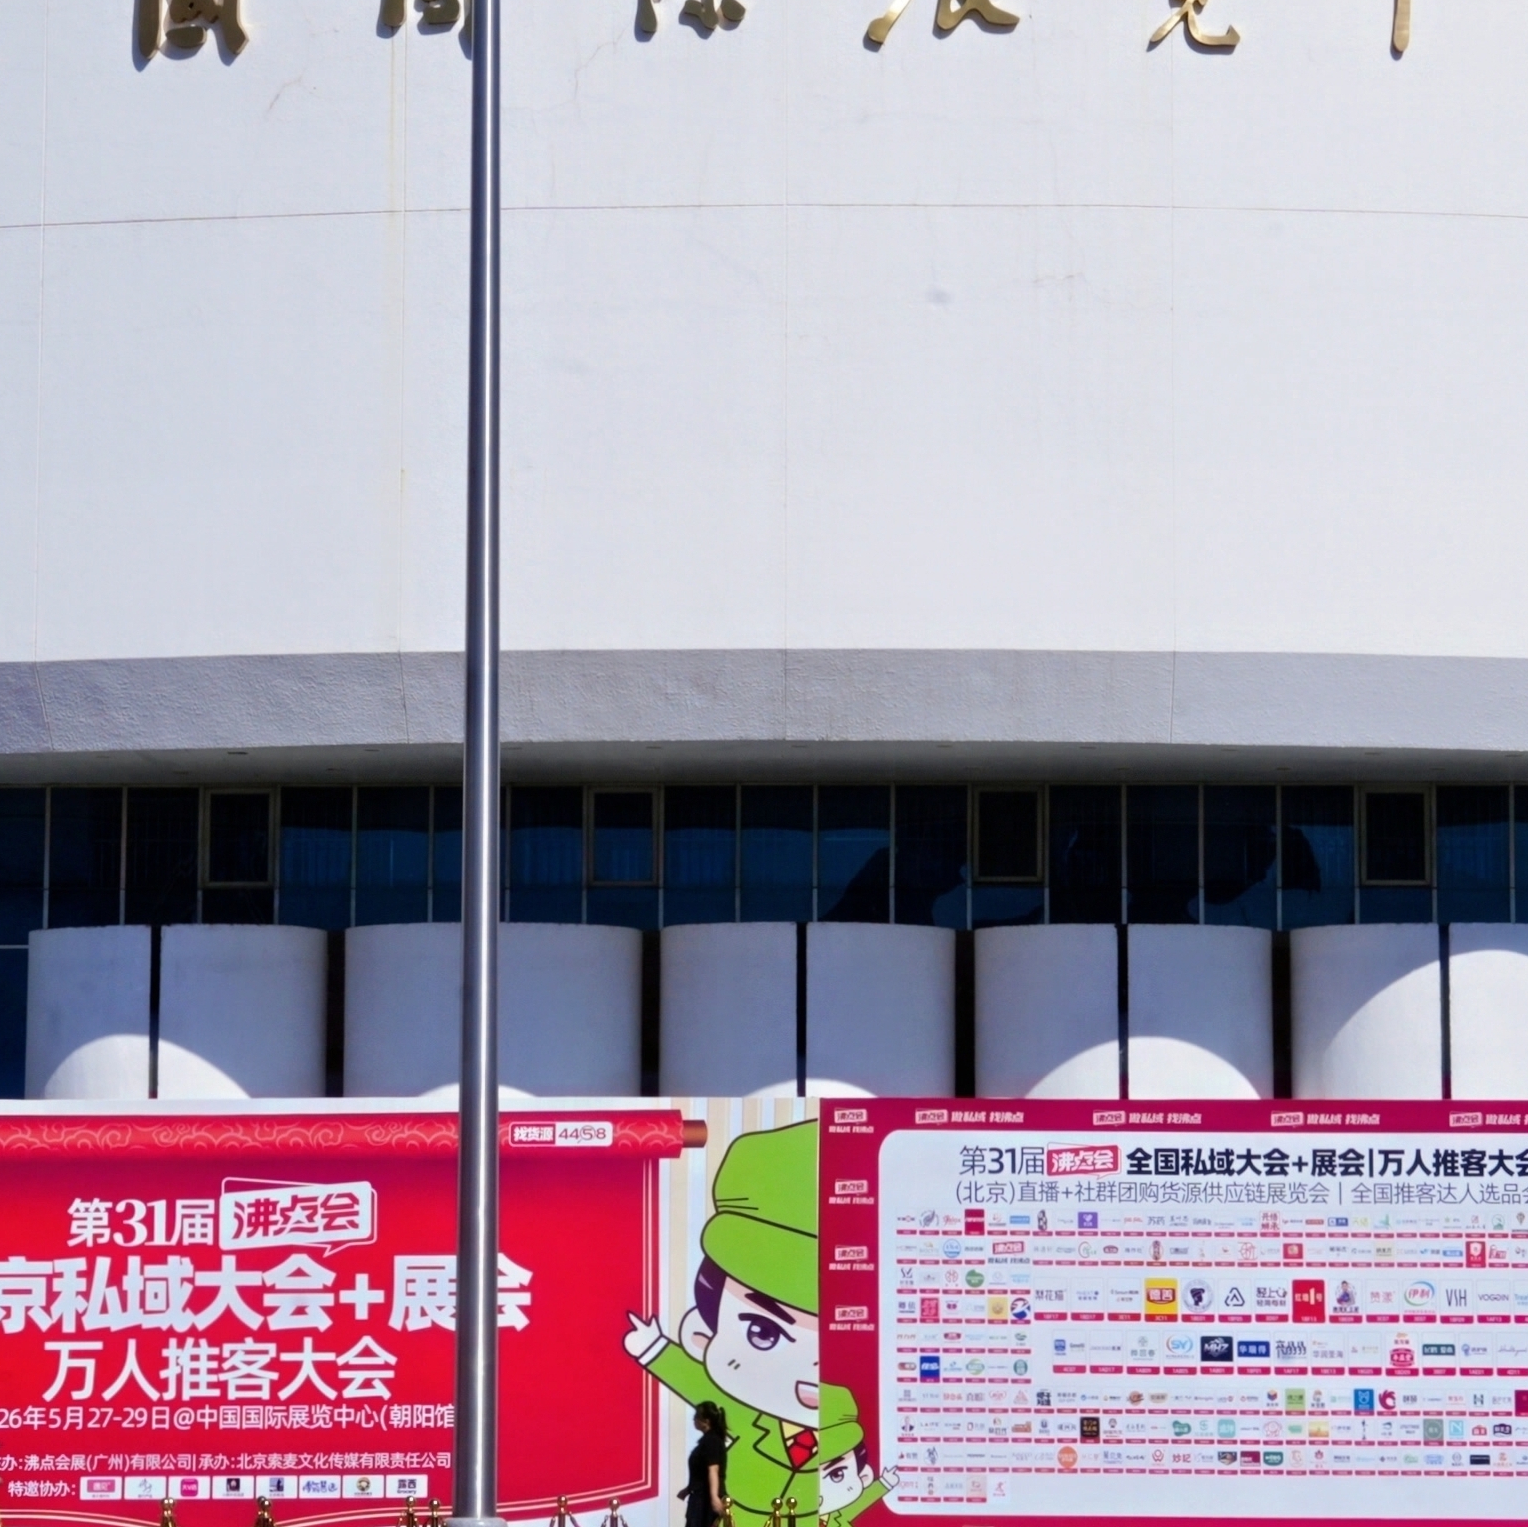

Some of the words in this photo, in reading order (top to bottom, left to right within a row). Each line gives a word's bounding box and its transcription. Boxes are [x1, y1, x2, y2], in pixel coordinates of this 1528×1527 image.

[959, 1145, 1045, 1176] 第31届
[1051, 1149, 1116, 1172] 沸点会
[66, 1197, 215, 1248] 第31届
[232, 1192, 360, 1241] 沸点会
[42, 1335, 398, 1402] 万人推客大会
